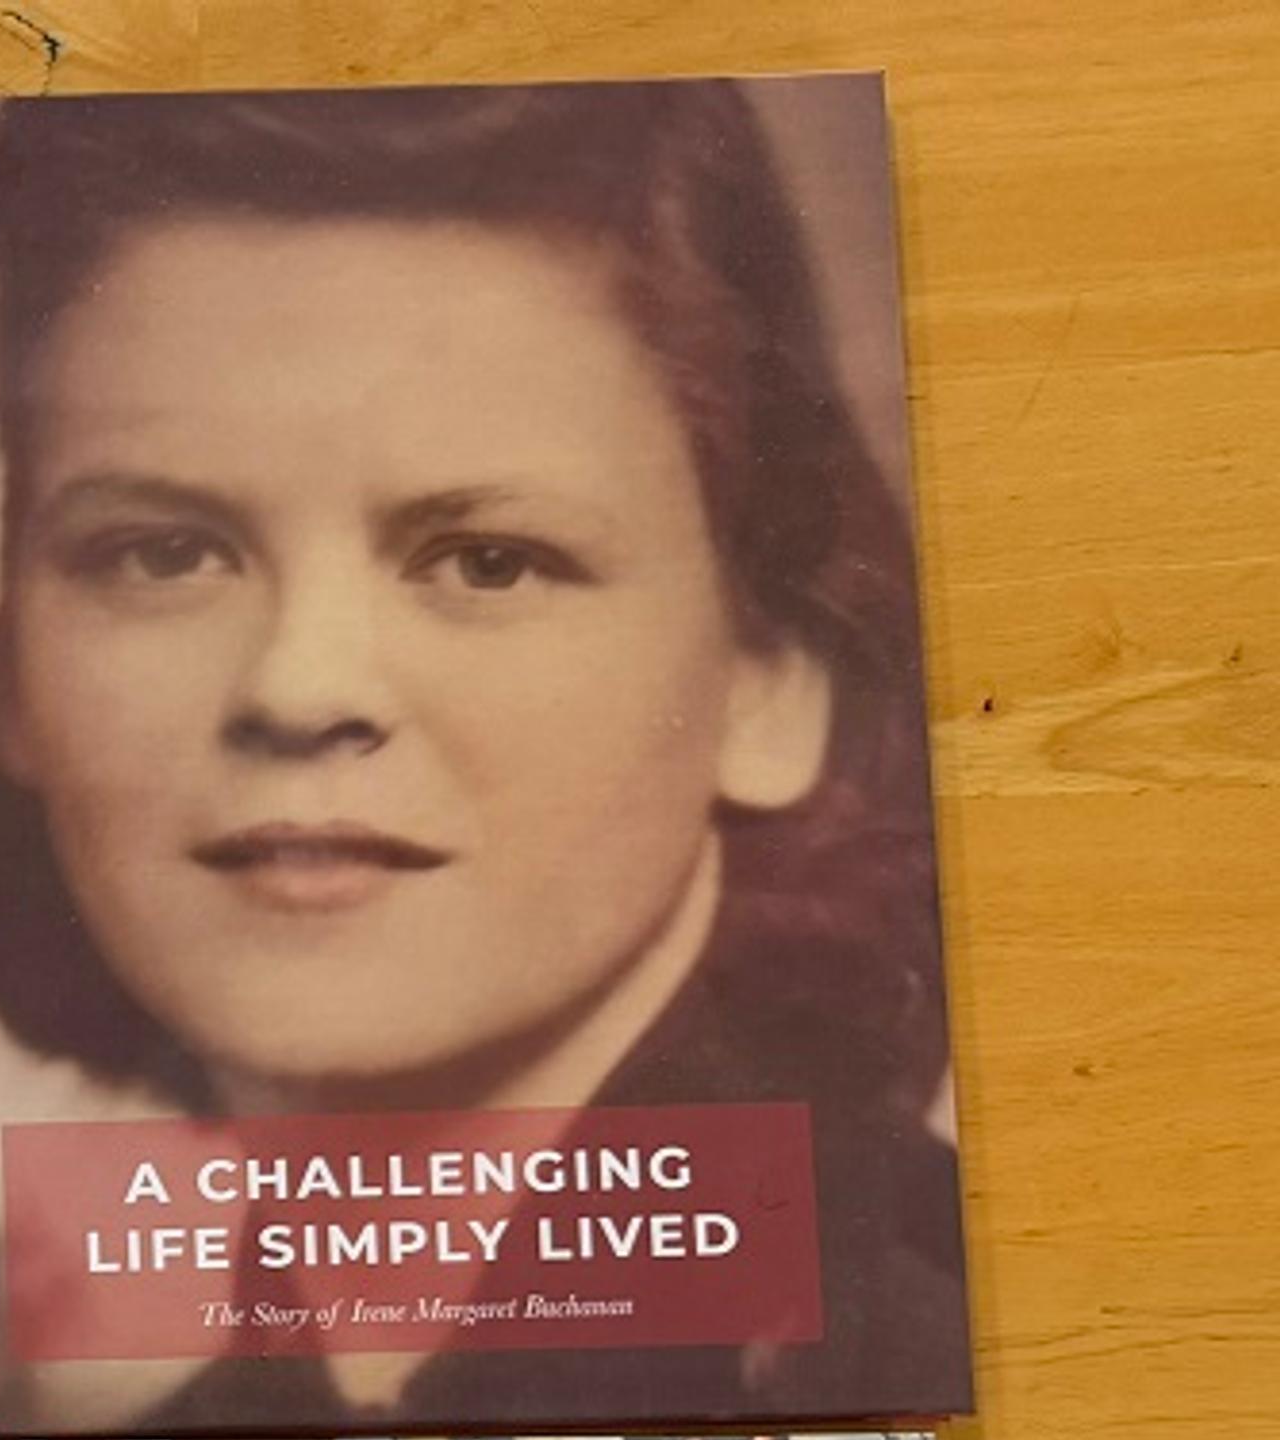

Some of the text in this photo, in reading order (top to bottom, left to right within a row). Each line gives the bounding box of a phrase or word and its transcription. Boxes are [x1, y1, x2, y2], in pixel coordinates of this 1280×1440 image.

[125, 1148, 690, 1203] A CHALLENGING
[88, 1214, 737, 1272] LIFE SIMPLY LIVED
[199, 1294, 632, 1331] The Story of Irene Margaret Buchanan
